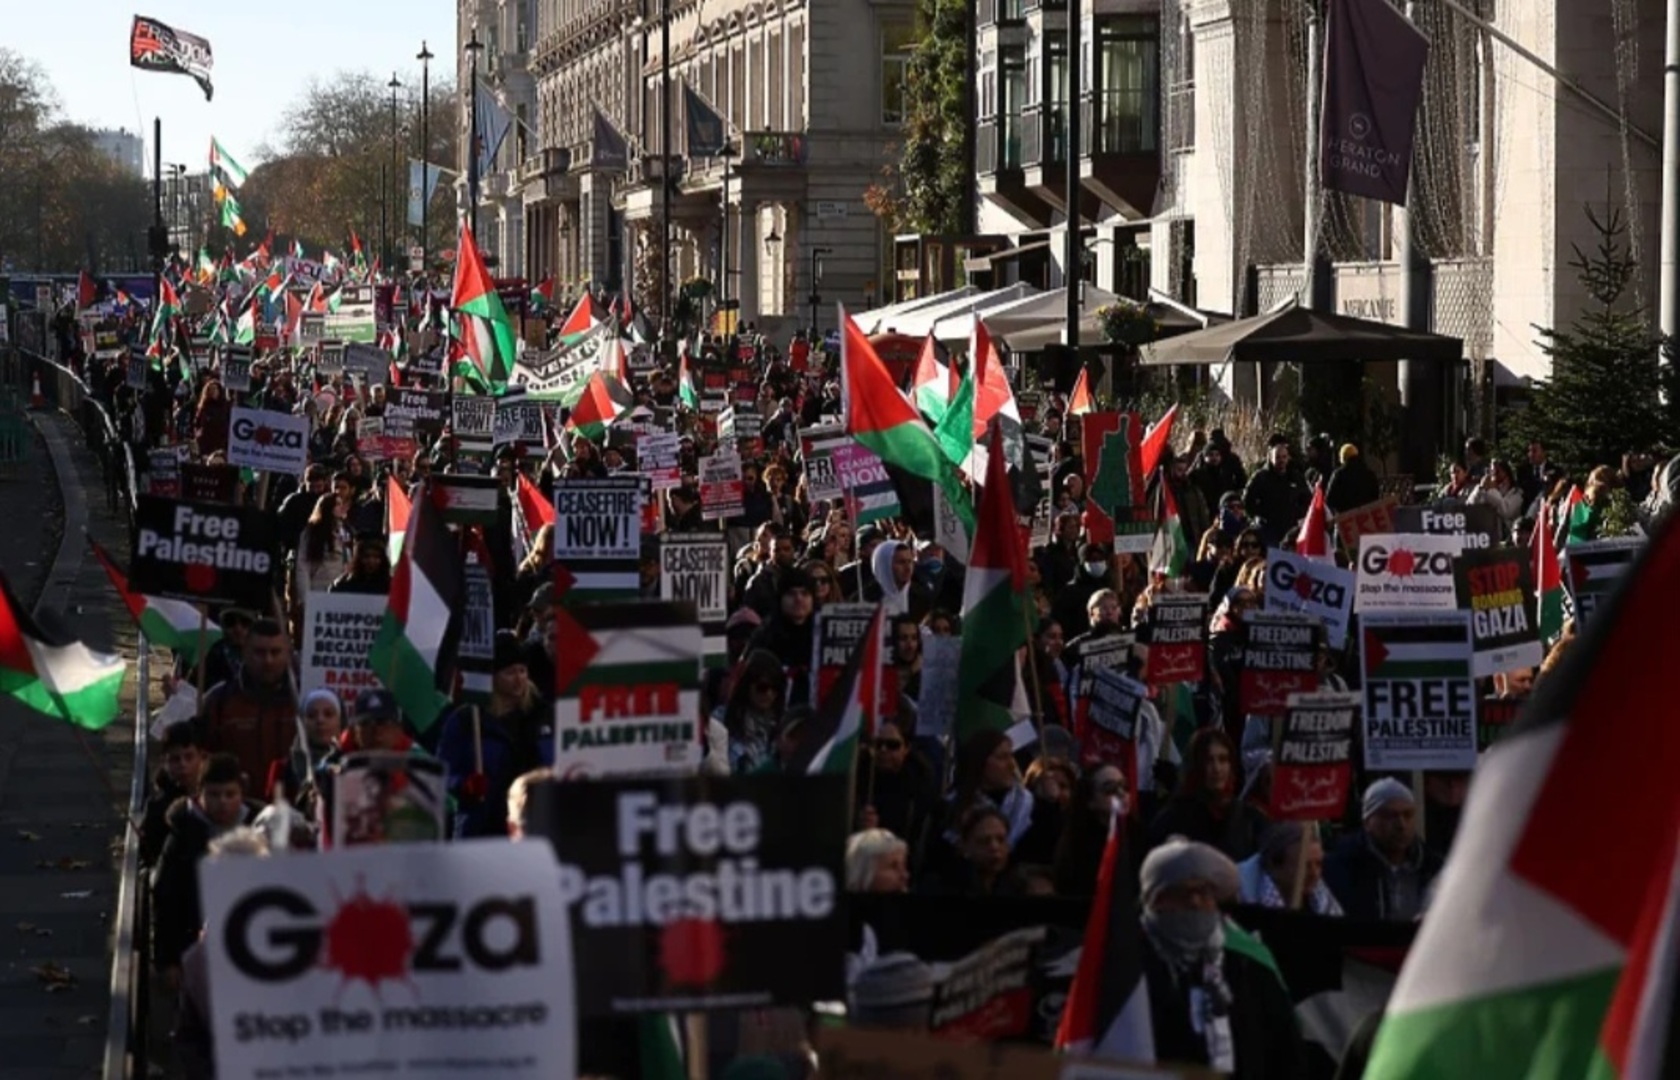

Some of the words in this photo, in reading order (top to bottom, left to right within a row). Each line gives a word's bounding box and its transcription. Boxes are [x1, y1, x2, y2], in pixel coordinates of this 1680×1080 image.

[1328, 137, 1401, 165] HERATON
[1329, 155, 1382, 179] GRAND
[232, 418, 303, 449] Gza
[842, 466, 890, 489] NOW
[558, 492, 637, 514] CEASEFIRE
[174, 506, 240, 539] Free
[567, 516, 630, 547] NOW!
[1421, 511, 1466, 532] Free
[138, 529, 270, 574] Palestine
[664, 547, 724, 572] CEASEFIRE
[1363, 545, 1452, 576] Gza
[671, 573, 719, 609] NOW!
[1270, 560, 1346, 610] Gza
[1360, 584, 1383, 596] Stop
[1468, 563, 1521, 594] STOP
[325, 613, 384, 628] SUPPOR
[1156, 606, 1203, 621] FREEDOM
[1475, 603, 1528, 639] GAZA
[1152, 627, 1203, 642] PALESTINE
[1250, 625, 1311, 644] FREEDOM
[1245, 650, 1313, 670] PALESTINE
[325, 671, 379, 687] BASIC
[579, 682, 680, 724] FREE
[1367, 681, 1471, 717] FREE
[1289, 711, 1354, 731] FREEDOM
[1368, 719, 1471, 737] PALESTINE
[562, 721, 694, 752] PALESTINE
[1280, 741, 1351, 763] PALESTINE
[616, 791, 761, 855] Free
[558, 857, 836, 927] Palestine
[223, 886, 541, 984] Gza
[234, 1011, 311, 1043] Stop
[320, 1005, 374, 1034] the
[382, 1003, 548, 1031] massacre
